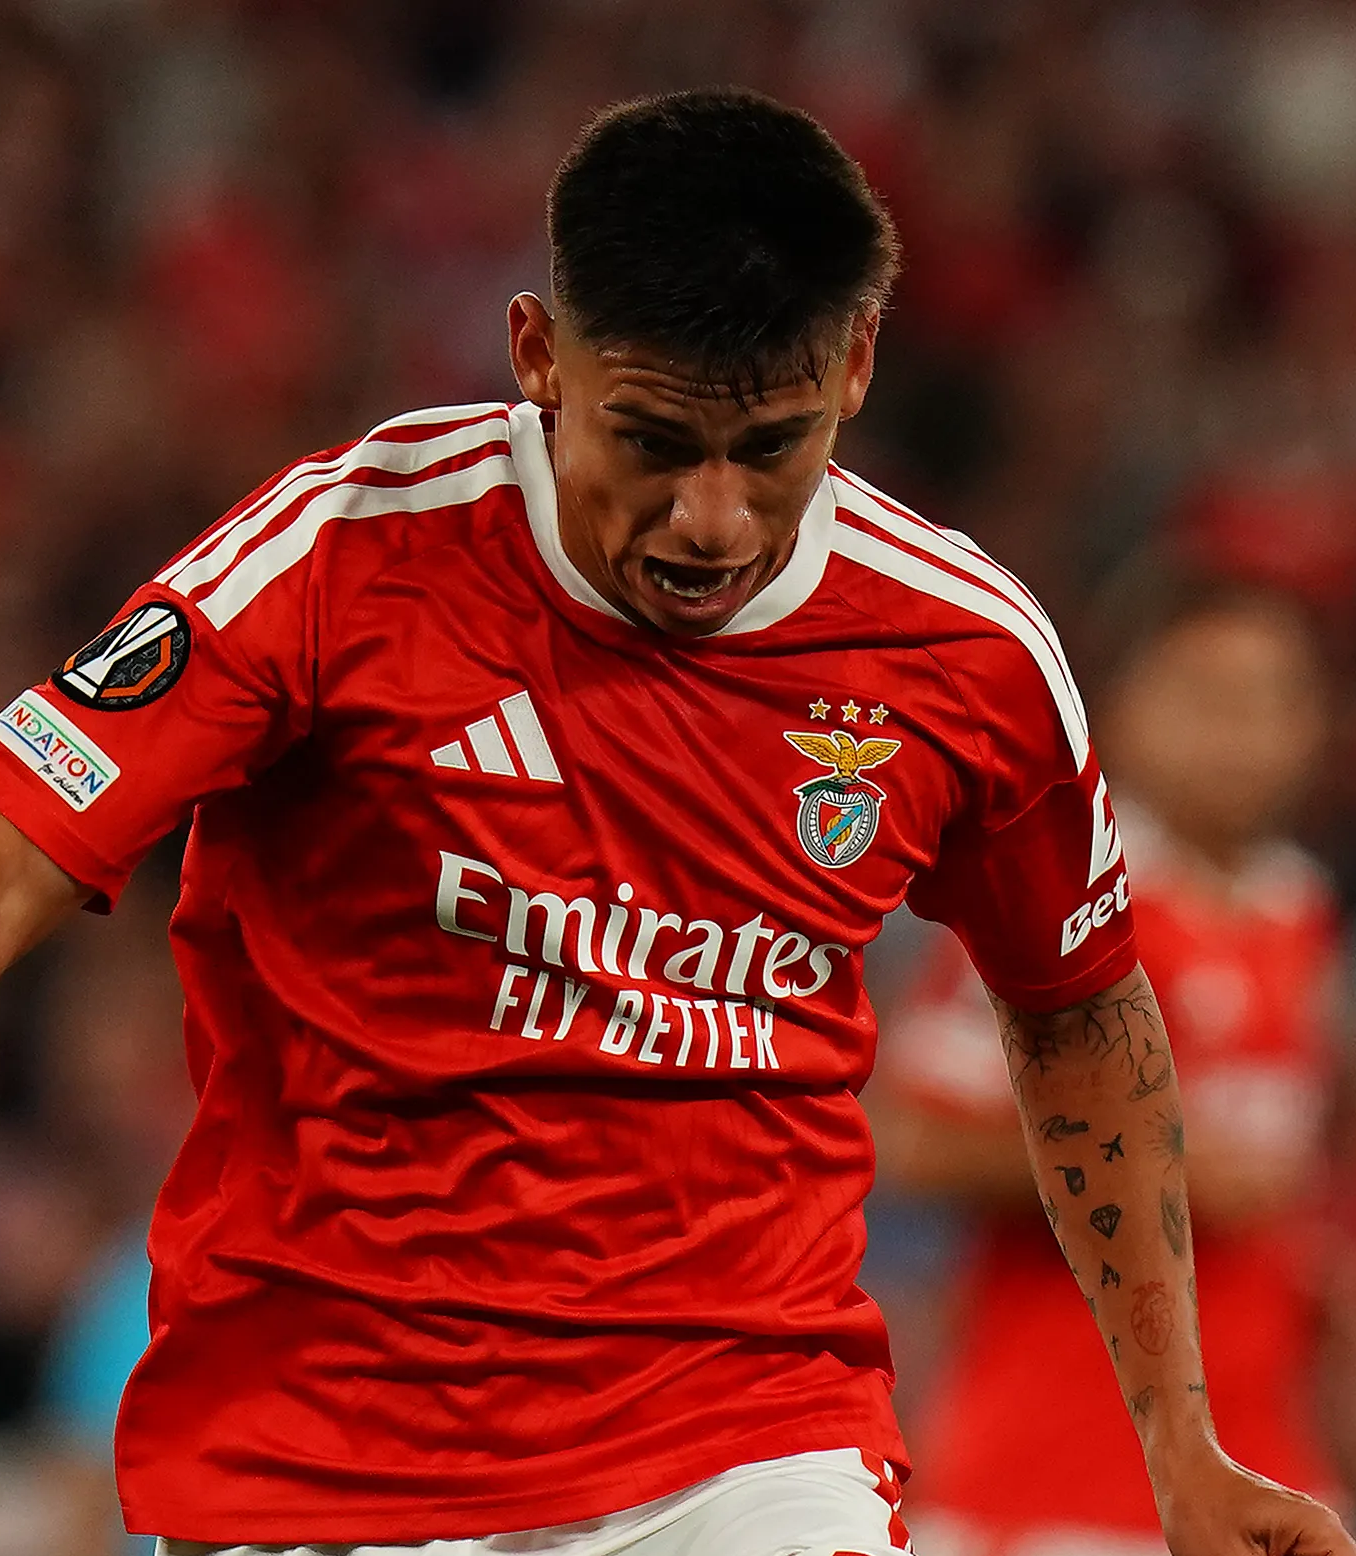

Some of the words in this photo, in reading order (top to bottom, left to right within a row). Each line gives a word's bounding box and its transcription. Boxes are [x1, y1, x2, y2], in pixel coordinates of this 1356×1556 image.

[435, 850, 849, 998] Emirates
[489, 963, 590, 1041] FLY
[599, 989, 781, 1070] BETTER
